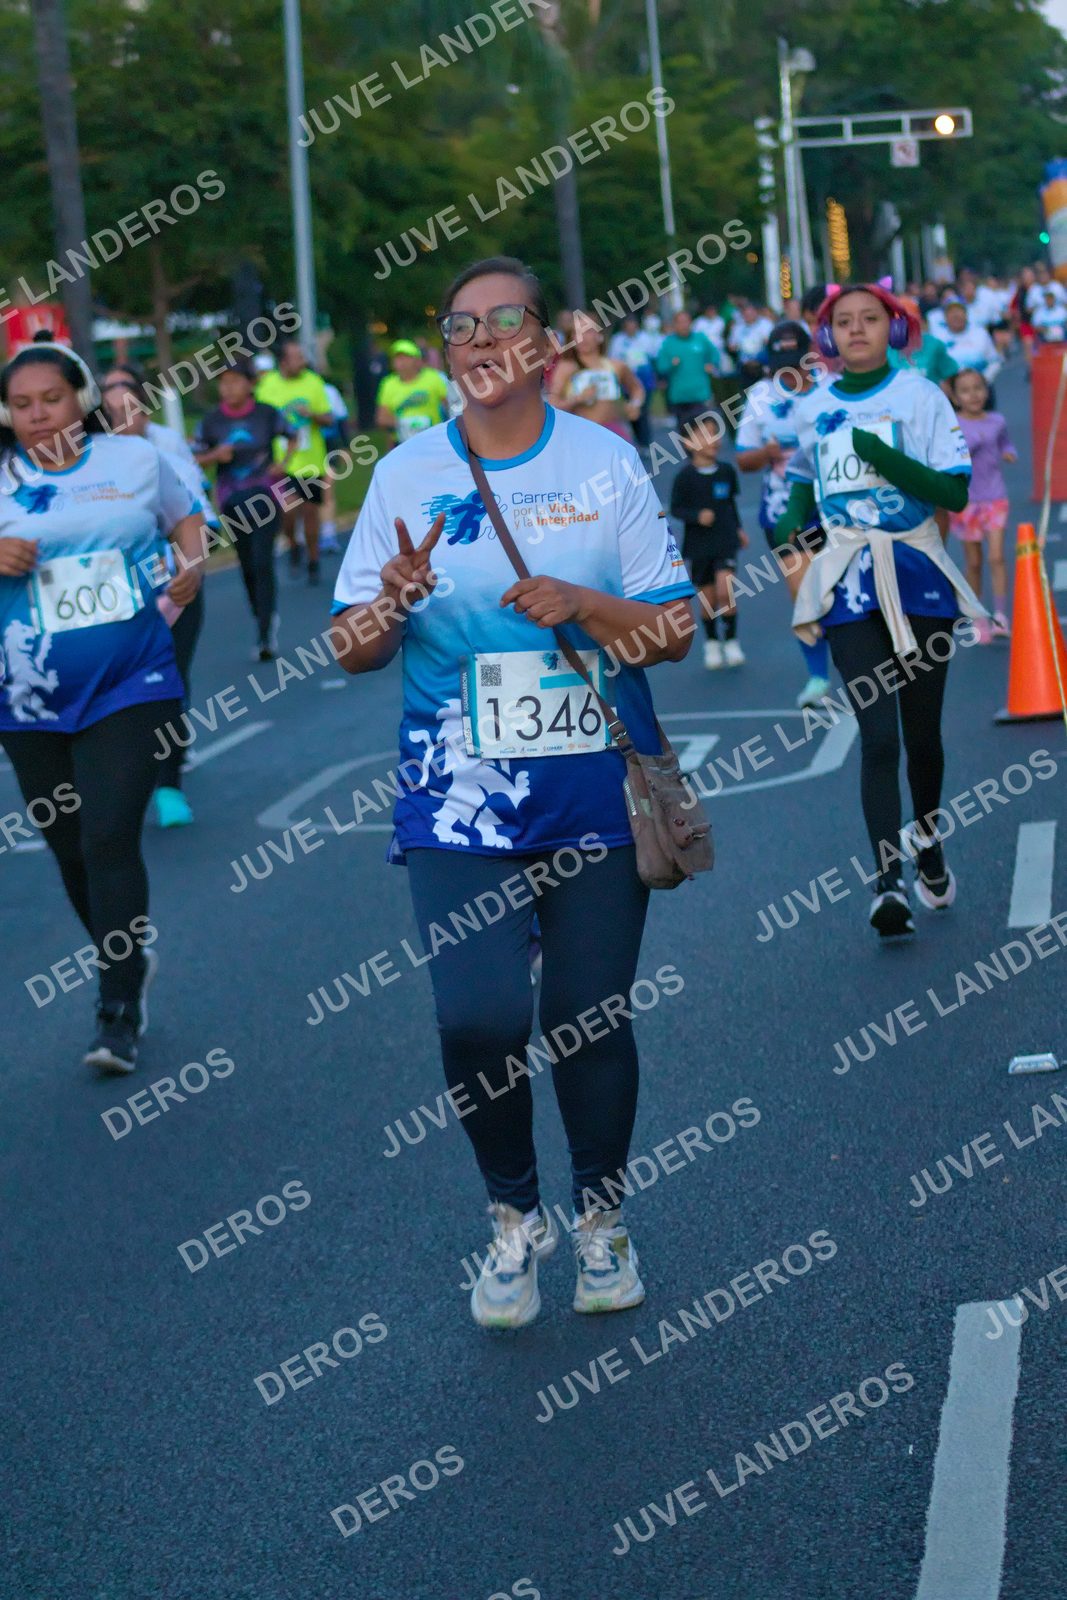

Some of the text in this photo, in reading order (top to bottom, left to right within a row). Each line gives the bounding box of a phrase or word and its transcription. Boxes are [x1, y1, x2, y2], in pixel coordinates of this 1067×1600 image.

[512, 492, 573, 504] Carrera
[513, 507, 532, 519] por
[548, 503, 576, 513] Vida
[536, 510, 599, 527] Integridad
[56, 582, 118, 620] 600
[487, 692, 602, 741] 1346
